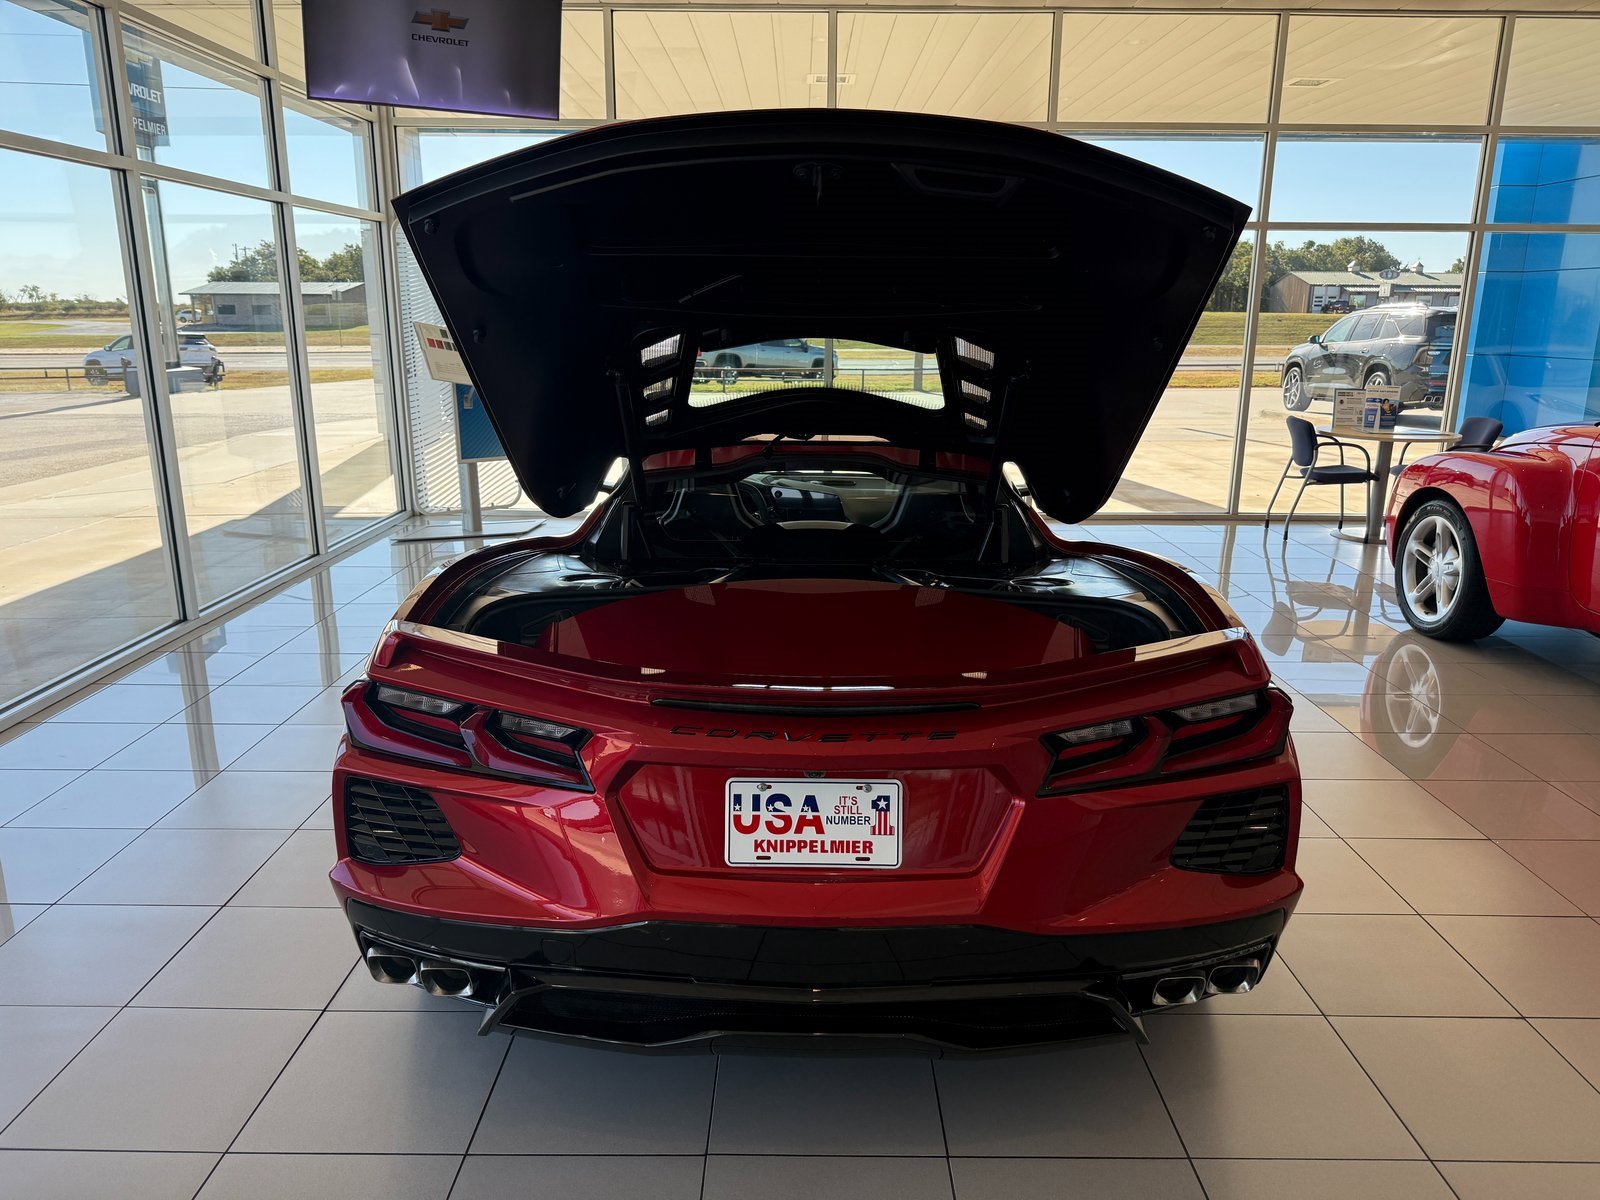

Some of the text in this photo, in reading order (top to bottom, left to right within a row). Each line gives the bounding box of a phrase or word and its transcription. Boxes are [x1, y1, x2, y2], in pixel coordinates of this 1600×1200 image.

[411, 33, 470, 47] CHEVROLET
[669, 725, 960, 743] CORVETTE
[839, 795, 858, 806] IT'S
[732, 793, 826, 836] USA
[825, 795, 896, 836] NUMBER 1
[833, 805, 863, 815] STILL
[753, 839, 874, 855] KNIPPELMIER
